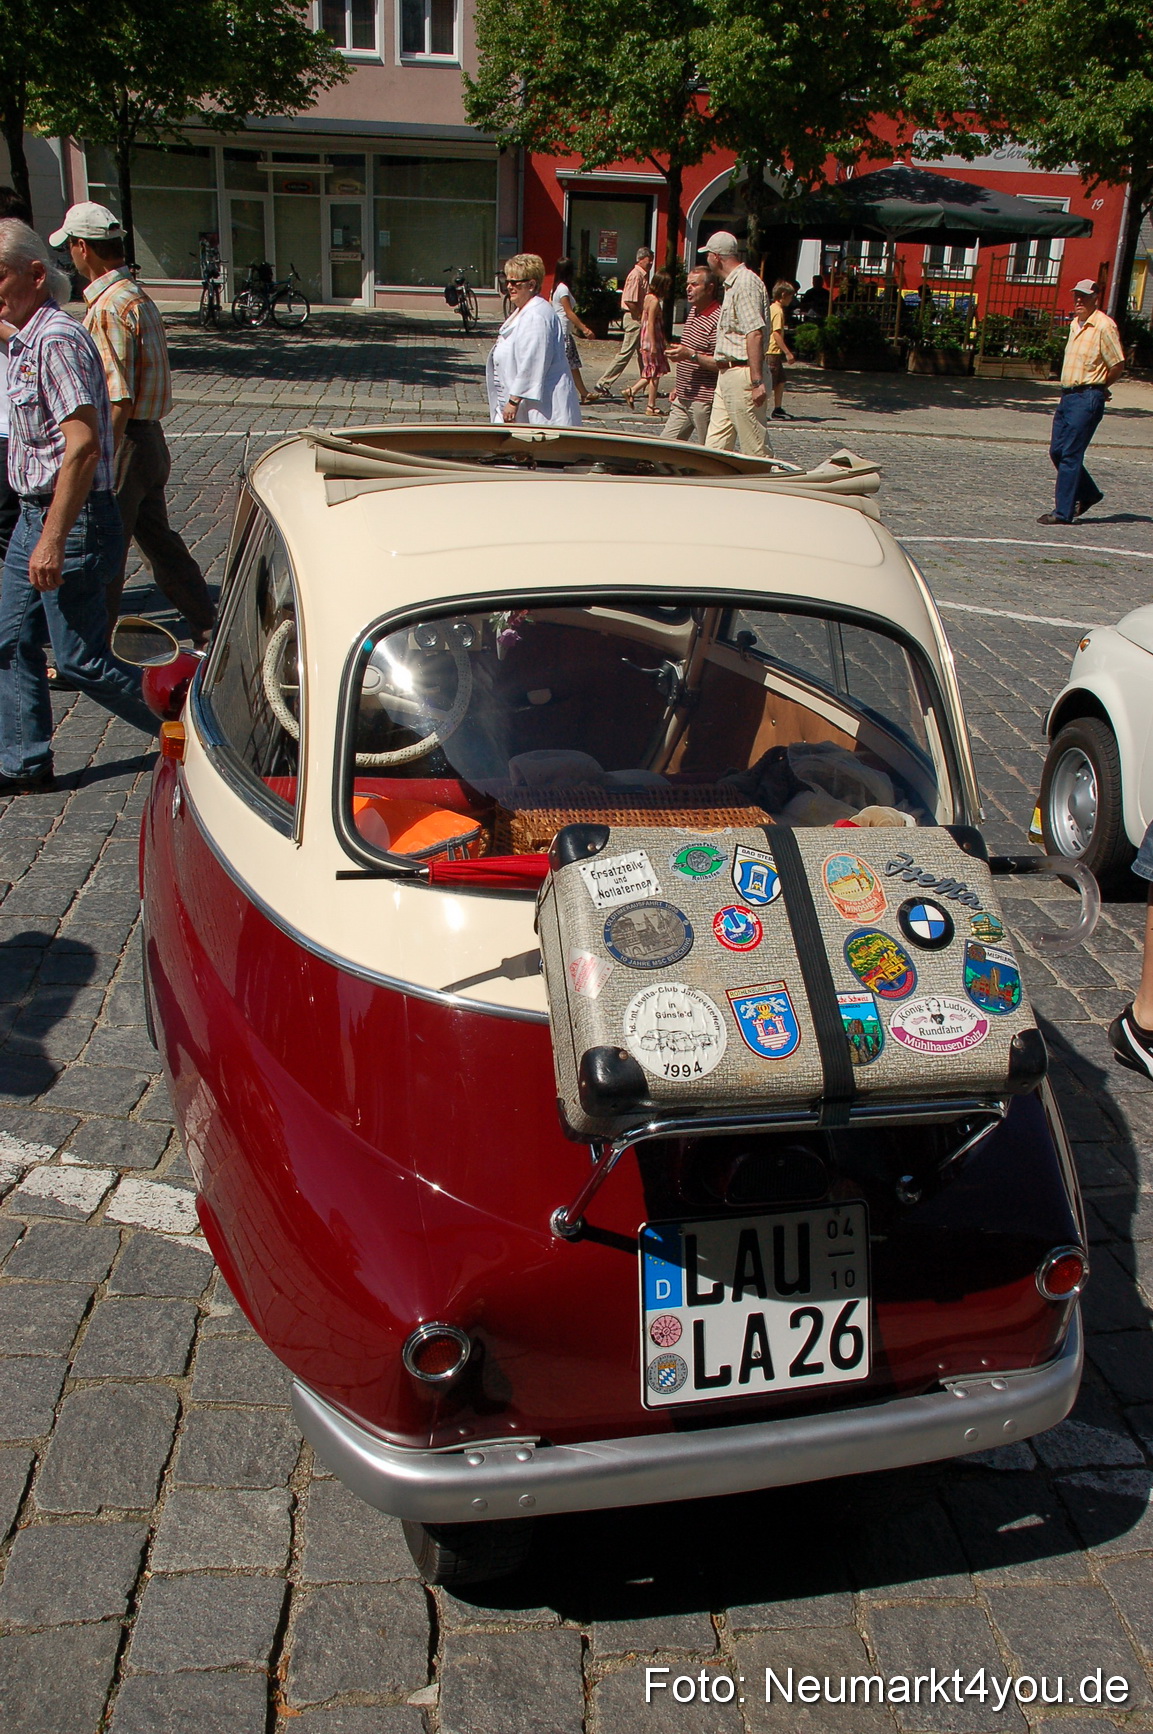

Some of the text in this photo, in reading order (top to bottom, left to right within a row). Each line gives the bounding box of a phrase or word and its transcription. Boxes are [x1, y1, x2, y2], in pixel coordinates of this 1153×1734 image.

[1091, 199, 1104, 210] 19
[741, 849, 756, 857] BAD
[590, 861, 644, 880] Ersatzteile
[613, 875, 628, 884] und
[884, 852, 984, 910] Isetta
[598, 879, 653, 899] Notlaternen
[628, 959, 652, 967] JAHRE
[652, 957, 668, 967] MSC
[667, 937, 692, 962] BERCHING
[635, 986, 679, 1008] Isetta-Club
[680, 987, 721, 1031] Jahrestreffen
[904, 1030, 984, 1052] Mühlhausen/Sulz
[918, 1025, 964, 1037] Rundfahrt
[663, 1060, 703, 1078] 1994
[827, 1217, 854, 1240] 04
[685, 1222, 811, 1307] LAU
[656, 1279, 671, 1300] D
[831, 1269, 856, 1291] 10
